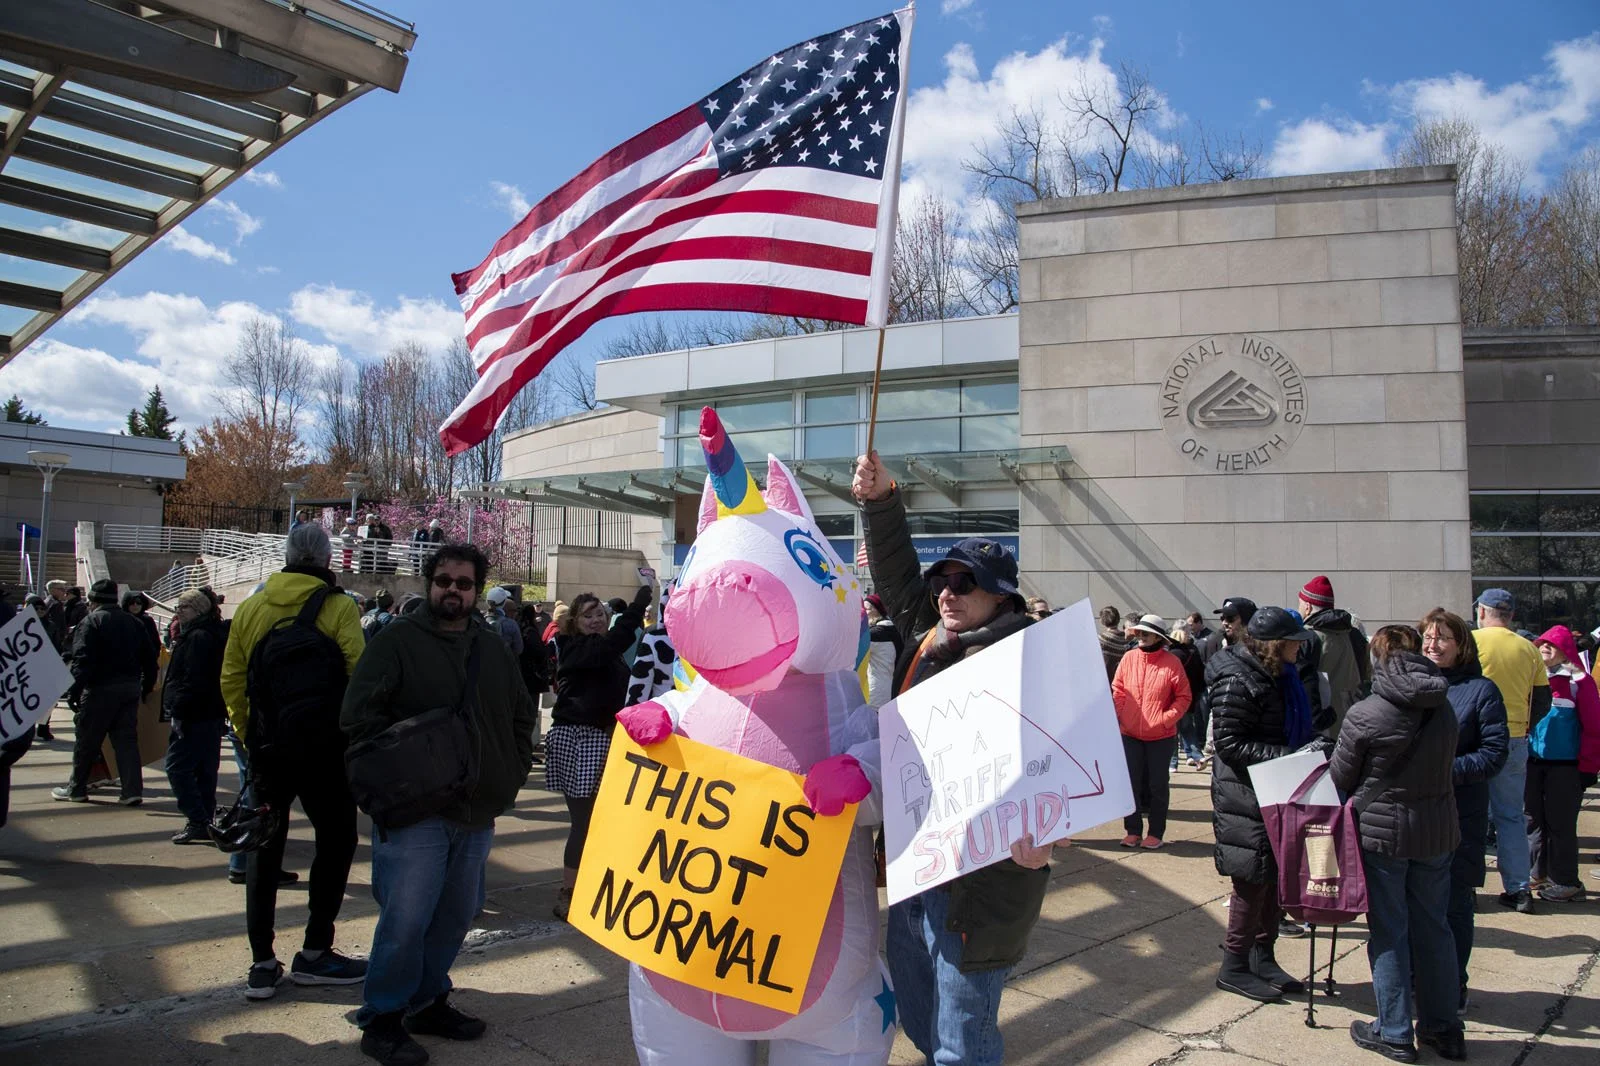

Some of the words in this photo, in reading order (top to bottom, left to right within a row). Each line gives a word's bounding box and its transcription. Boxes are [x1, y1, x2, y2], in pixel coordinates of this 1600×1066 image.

[1162, 340, 1223, 420] NATIONAL
[1241, 337, 1304, 425] INSTITUTES
[1181, 438, 1209, 461] OF
[1215, 433, 1288, 472] HEALTH
[0, 617, 43, 674] NGS
[624, 751, 736, 830] THIS
[759, 800, 817, 857] IS
[899, 743, 953, 803] PUT
[972, 730, 988, 755] A
[904, 753, 1012, 831] TARIFF
[1026, 754, 1052, 777] ON
[638, 828, 768, 905] NOT
[912, 784, 1071, 886] STUPID!
[1306, 880, 1340, 893] Reico
[590, 867, 793, 994] NORMAL
